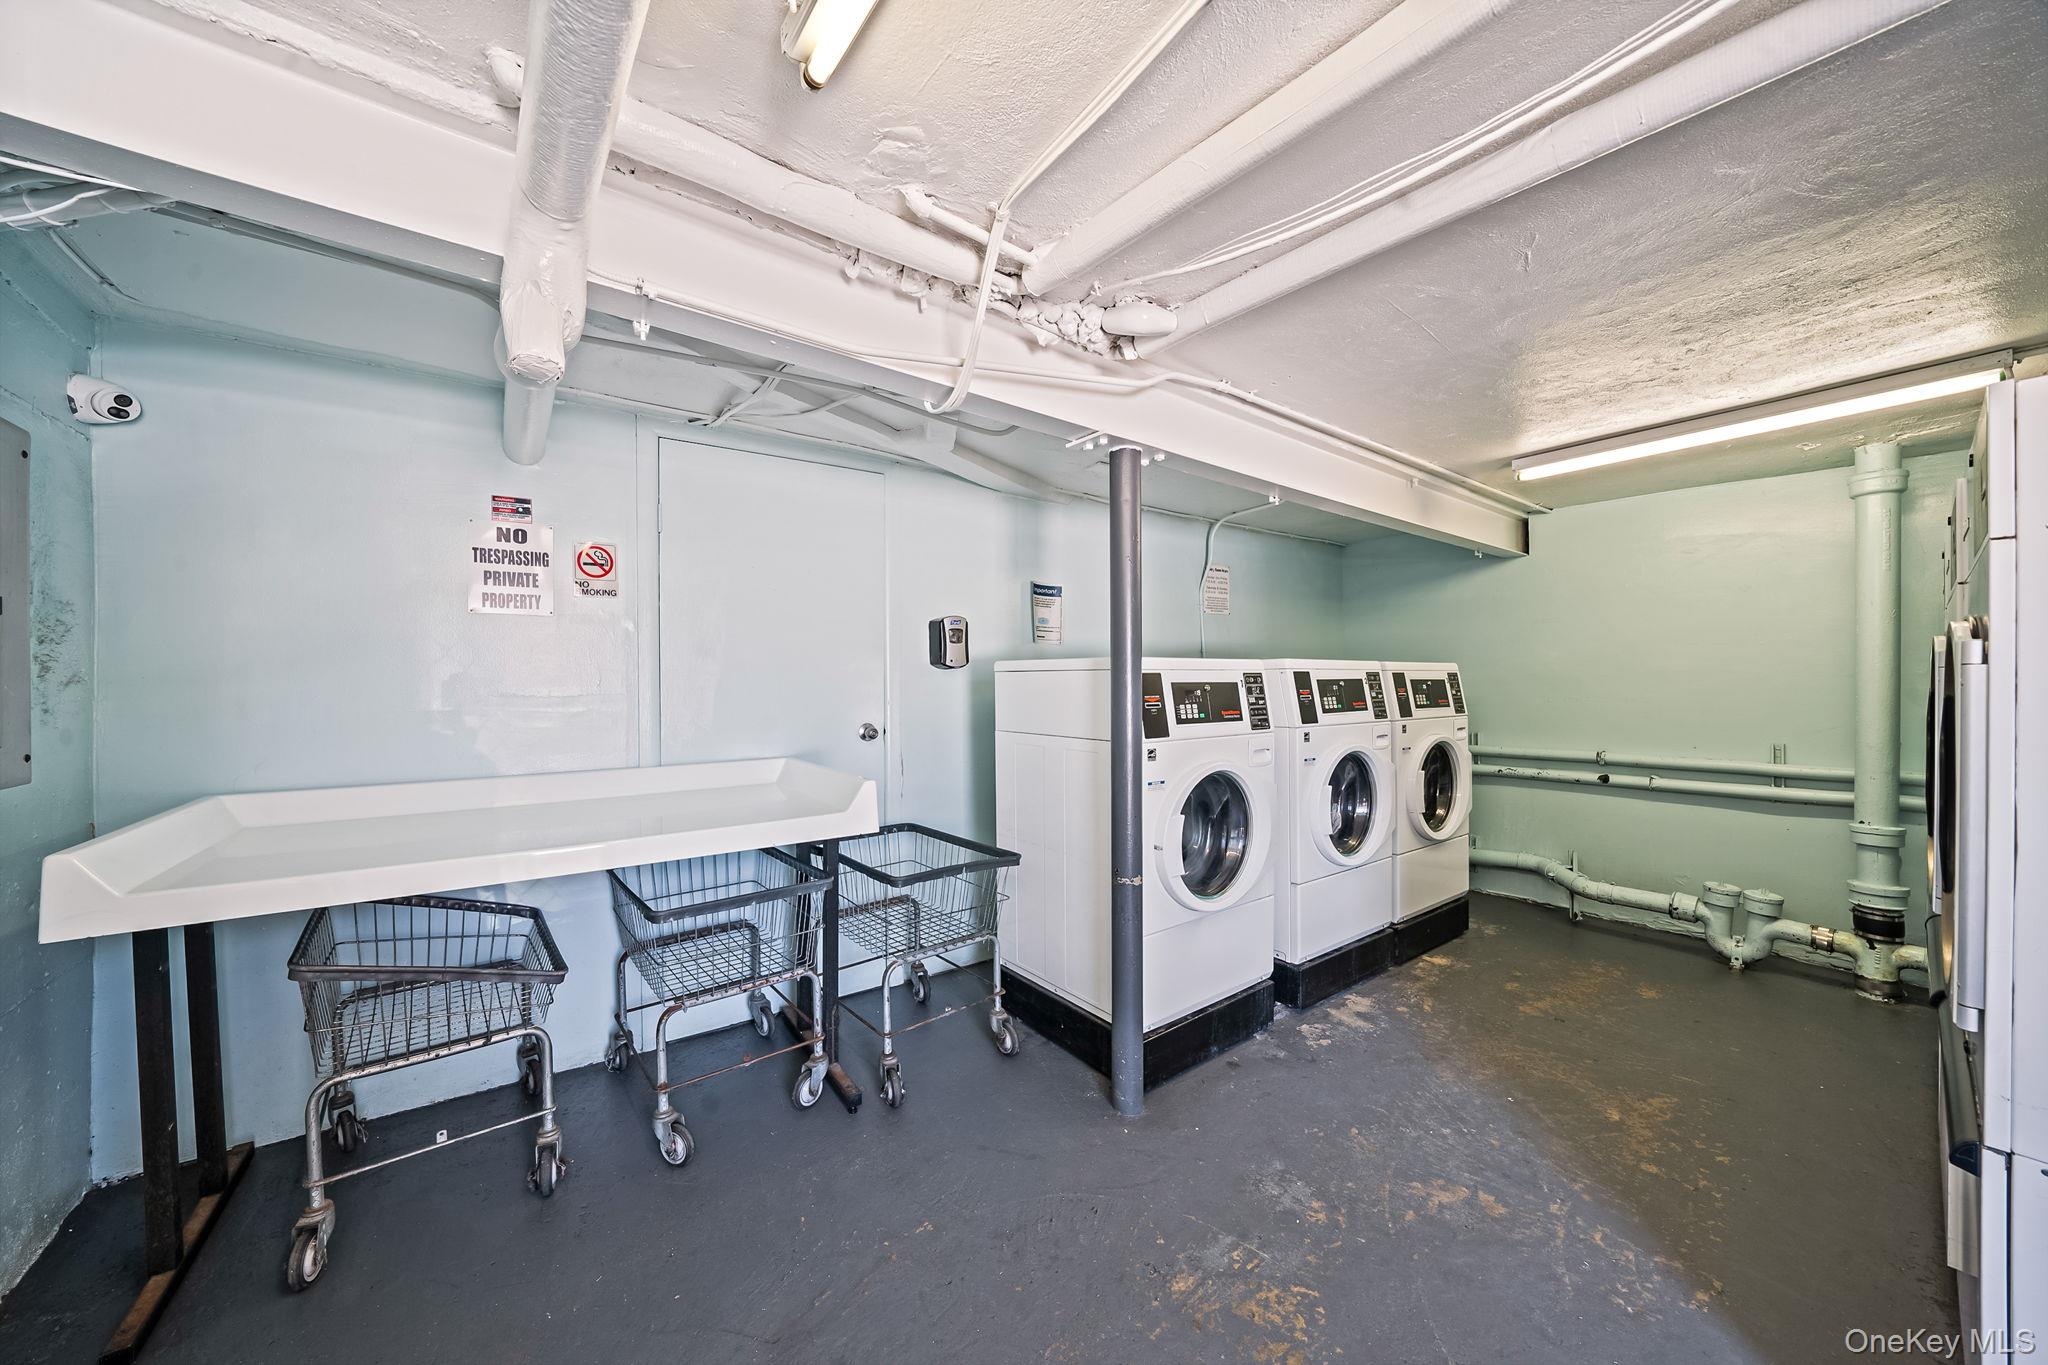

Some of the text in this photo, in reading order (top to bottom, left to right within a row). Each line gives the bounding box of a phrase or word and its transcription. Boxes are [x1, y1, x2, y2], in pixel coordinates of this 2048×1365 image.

[496, 526, 528, 544] NO
[472, 547, 550, 568] TRESPASSING
[483, 570, 540, 589] PRIVATE
[575, 580, 590, 588] NO
[481, 592, 542, 610] PROPERTY
[576, 588, 617, 597] MOKING
